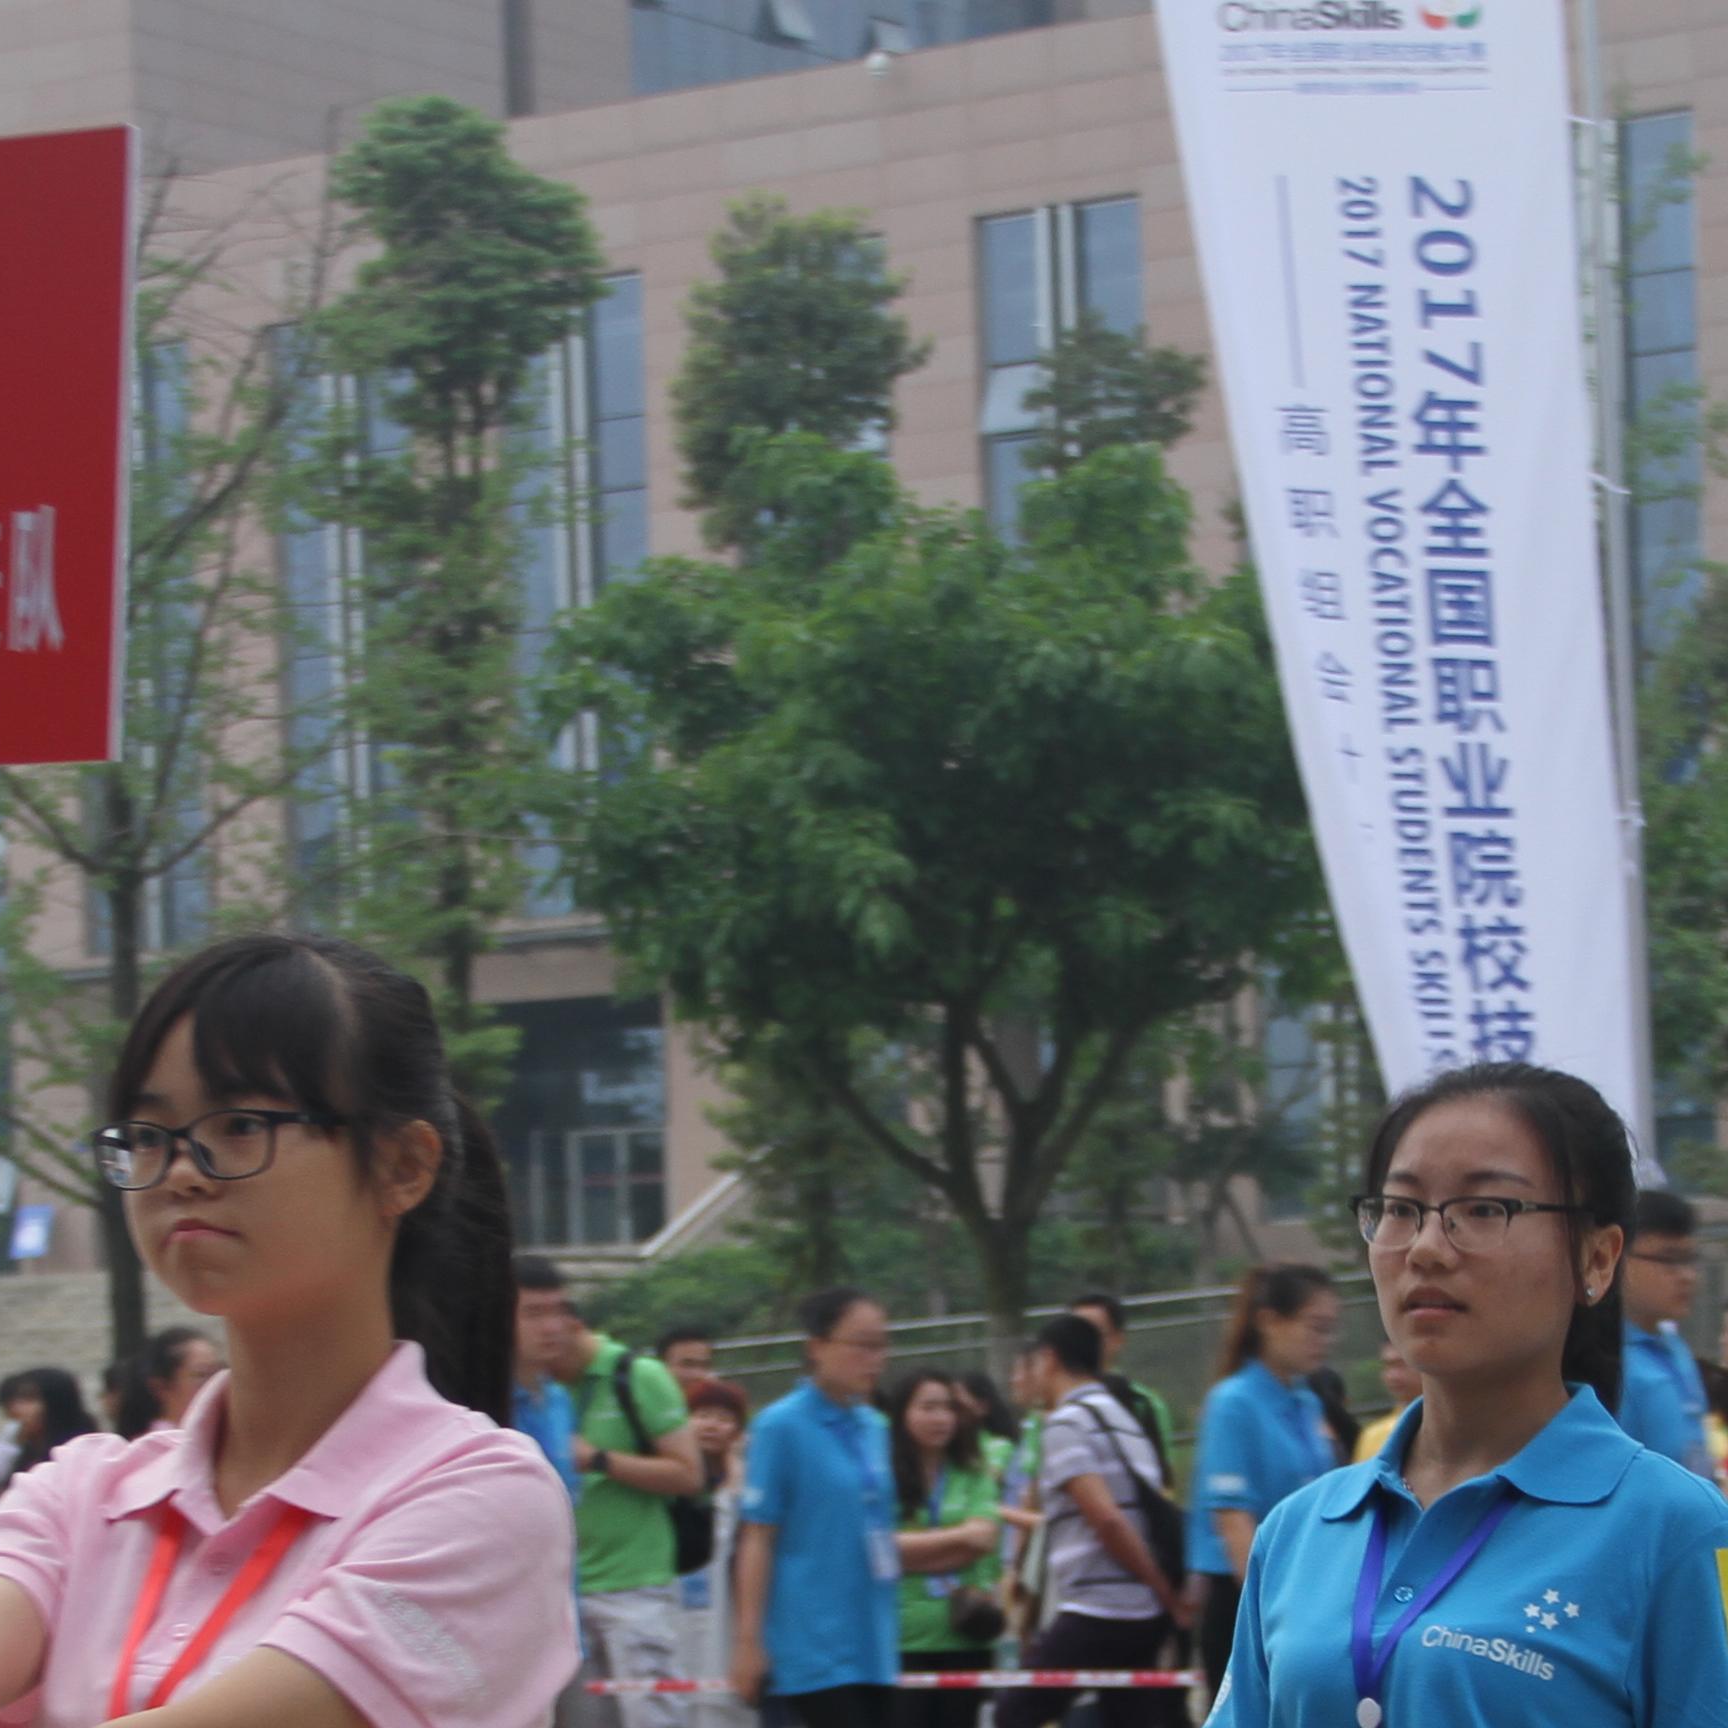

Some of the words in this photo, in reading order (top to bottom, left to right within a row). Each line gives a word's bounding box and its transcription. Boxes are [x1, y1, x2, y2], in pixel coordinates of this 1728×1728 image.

[1335, 176, 1385, 269] 2017
[1344, 283, 1400, 477] NATIONAL
[1365, 487, 1422, 733] VOCATIONAL
[1385, 745, 1444, 937] STUDENTS
[1422, 1624, 1556, 1681] ChinaSkills
